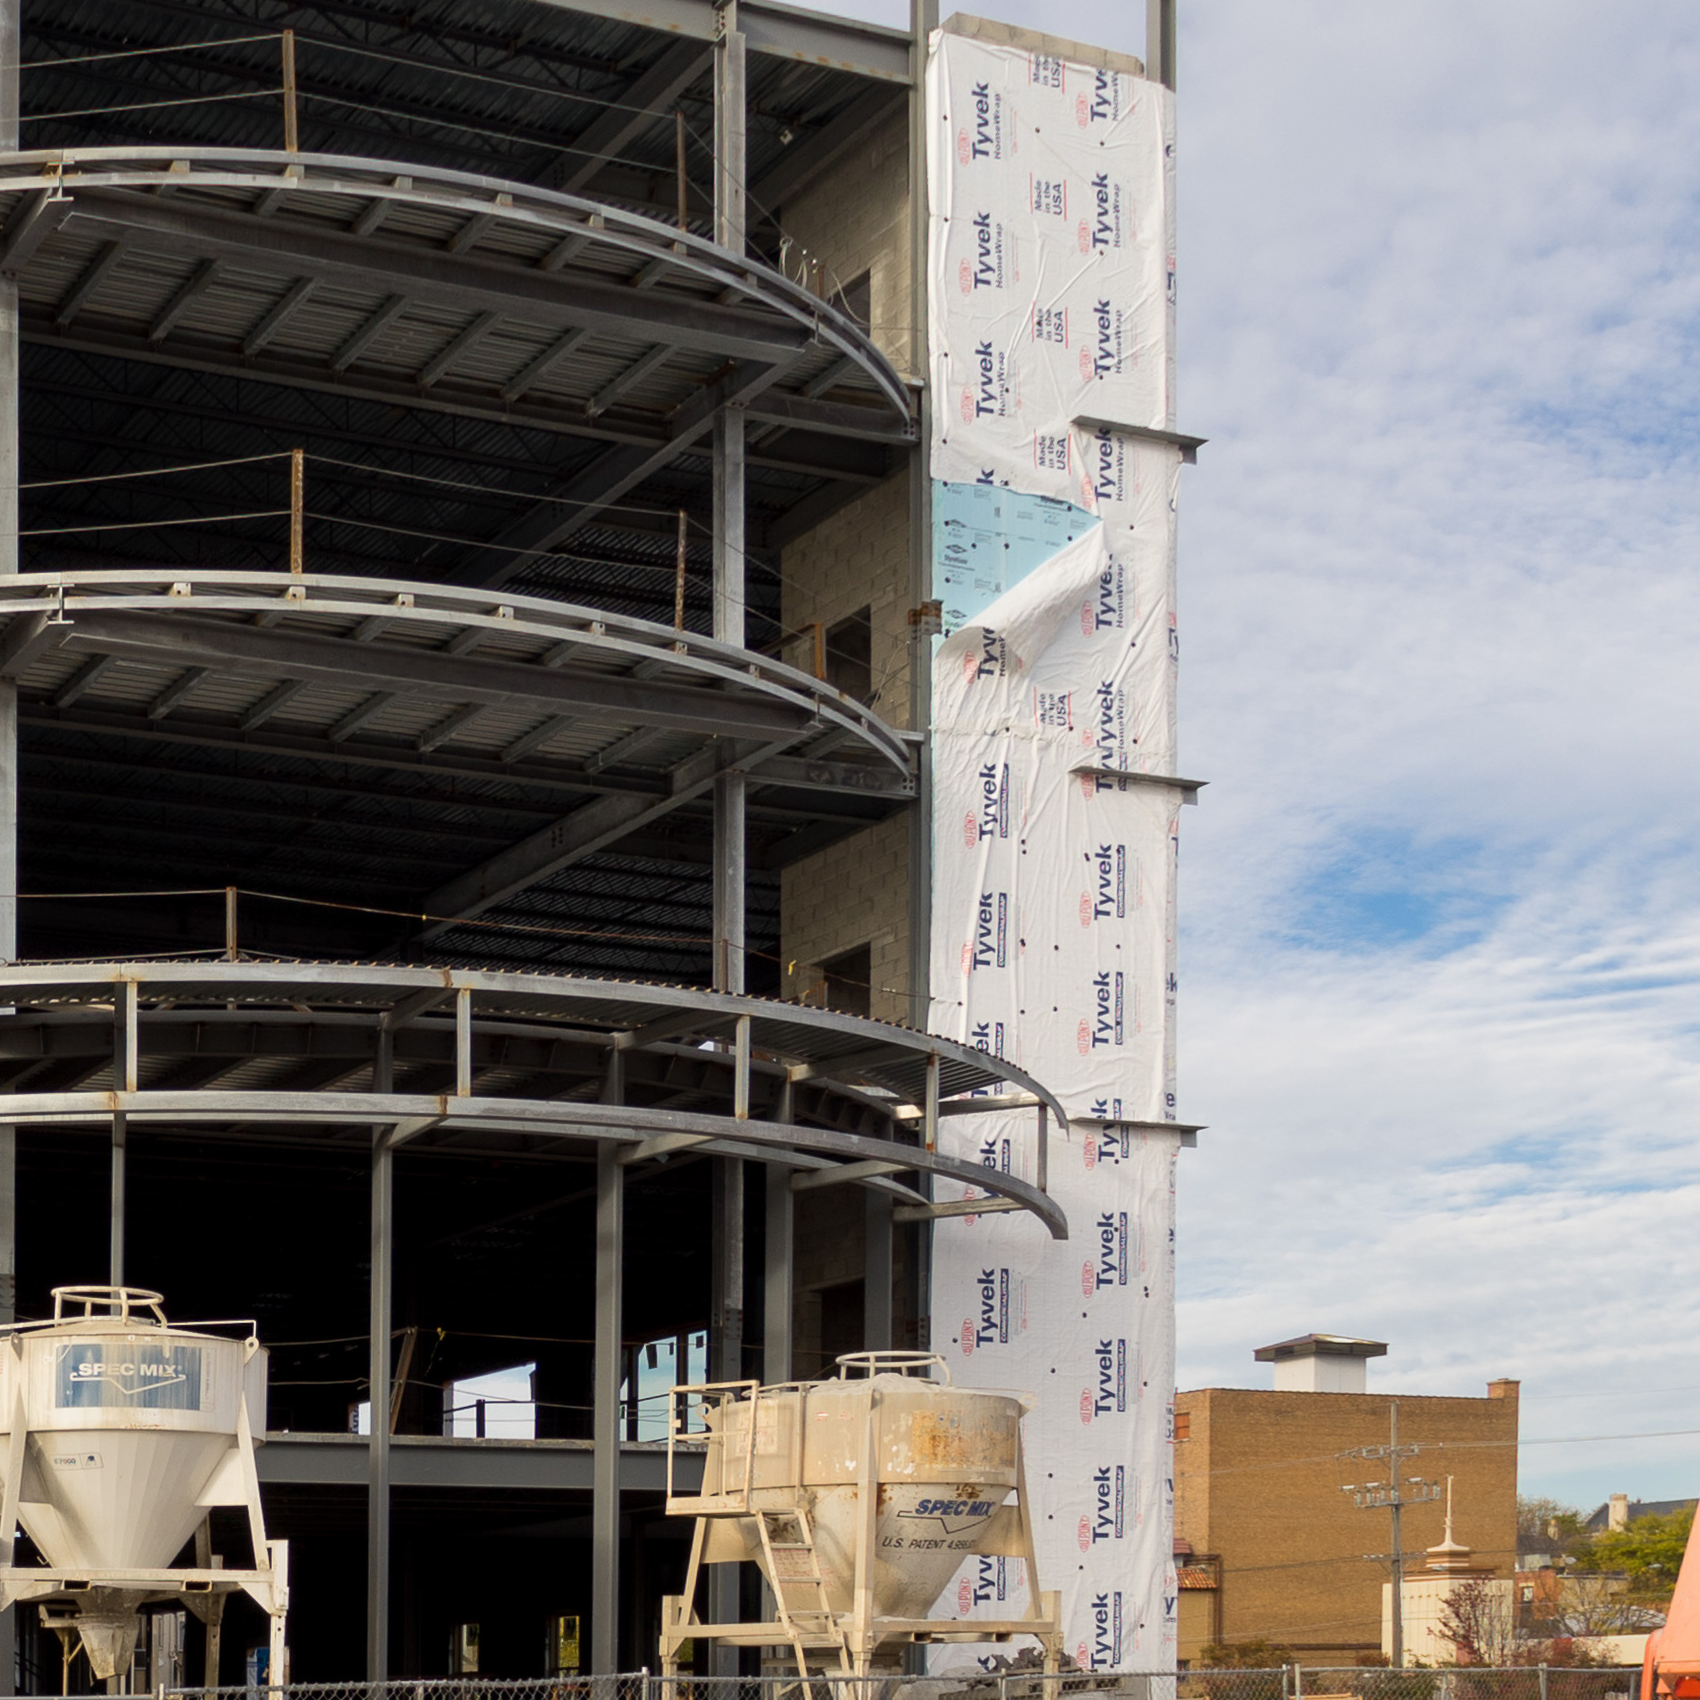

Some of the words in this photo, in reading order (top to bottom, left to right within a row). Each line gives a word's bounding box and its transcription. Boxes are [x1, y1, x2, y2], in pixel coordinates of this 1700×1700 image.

[972, 81, 993, 159] Tyvek
[1090, 68, 1111, 122] Tyve
[1053, 183, 1062, 216] USA
[1091, 172, 1113, 248] Tyvek
[973, 211, 995, 289] Tyvek
[1054, 311, 1063, 343] USA
[1094, 299, 1114, 375] Tyvek
[975, 341, 997, 417] Tyvek
[1057, 438, 1066, 470] USA
[1095, 426, 1115, 500] Tyvek
[1096, 554, 1116, 630] Tyve
[1057, 694, 1067, 726] USA
[979, 764, 998, 841] Tyvek
[1094, 844, 1115, 920] Tyvek
[973, 892, 995, 970] Tyvek
[1092, 972, 1113, 1048] Tyvek
[1097, 1212, 1117, 1290] Tyvek
[961, 1319, 974, 1355] DUPONT
[976, 1268, 998, 1348] Tyvek
[78, 1363, 135, 1376] SPEC
[140, 1364, 176, 1377] MIX
[1095, 1339, 1115, 1417] Tyvek
[915, 1499, 969, 1516] SPEC
[966, 1501, 995, 1516] MIX
[1079, 1517, 1089, 1551] DUPONT
[1093, 1466, 1113, 1544] Tyvek
[882, 1536, 903, 1548] U.S.
[908, 1539, 947, 1550] PATENT
[973, 1555, 995, 1606] Tyv
[959, 1579, 971, 1613] DUPONT
[1090, 1593, 1112, 1668] Tyvek
